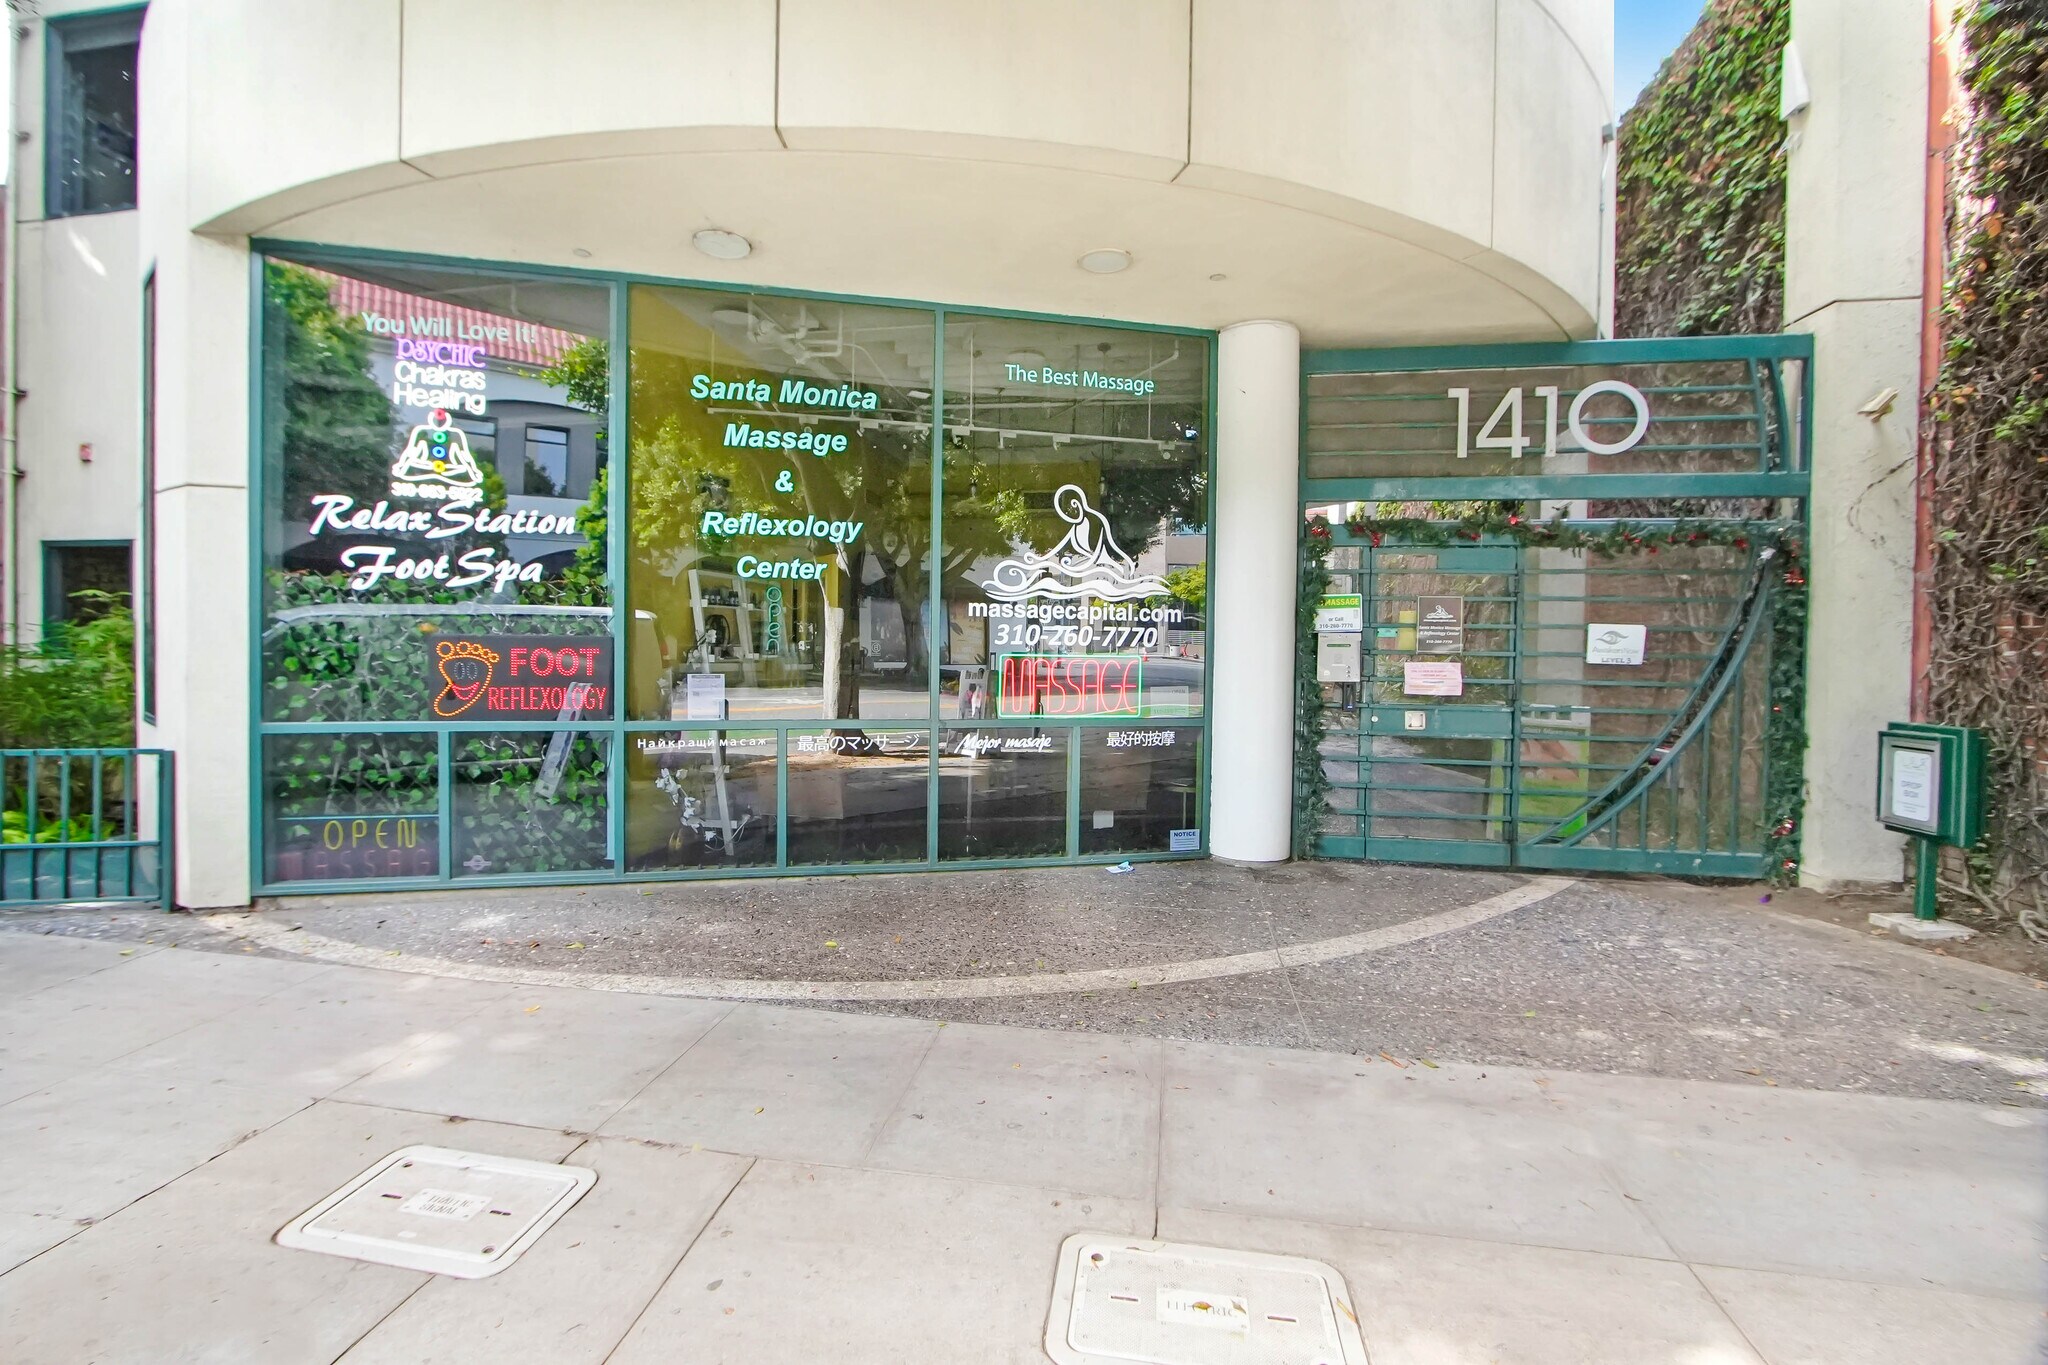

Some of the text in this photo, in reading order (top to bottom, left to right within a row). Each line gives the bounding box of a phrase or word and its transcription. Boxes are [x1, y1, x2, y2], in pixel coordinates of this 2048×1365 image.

[361, 312, 536, 344] You Will Love It!
[394, 360, 487, 391] Chakras
[1005, 364, 1155, 396] The Best Massage
[393, 381, 487, 416] Healing
[690, 374, 878, 410] Santa Monica
[1447, 380, 1650, 458] 1410
[723, 423, 848, 456] Massage
[774, 470, 794, 492] &
[309, 494, 576, 539] Relax Station
[702, 511, 863, 543] Reflexology
[341, 545, 543, 593] Foot Spa
[736, 556, 828, 580] Center
[968, 601, 1182, 624] massagecapital.com
[1324, 598, 1359, 606] MASSAGE
[994, 623, 1158, 648] 310-260-7770
[510, 647, 600, 677] FOOT
[487, 686, 607, 710] REFLEXOLOGY
[1001, 657, 1138, 713] MASSAGE
[719, 736, 767, 748] масаж
[797, 734, 920, 752] 最高のマッサージ
[954, 733, 1052, 755] Mejor masaje
[1106, 730, 1176, 748] 最好的按摩
[323, 819, 418, 850] OPEN
